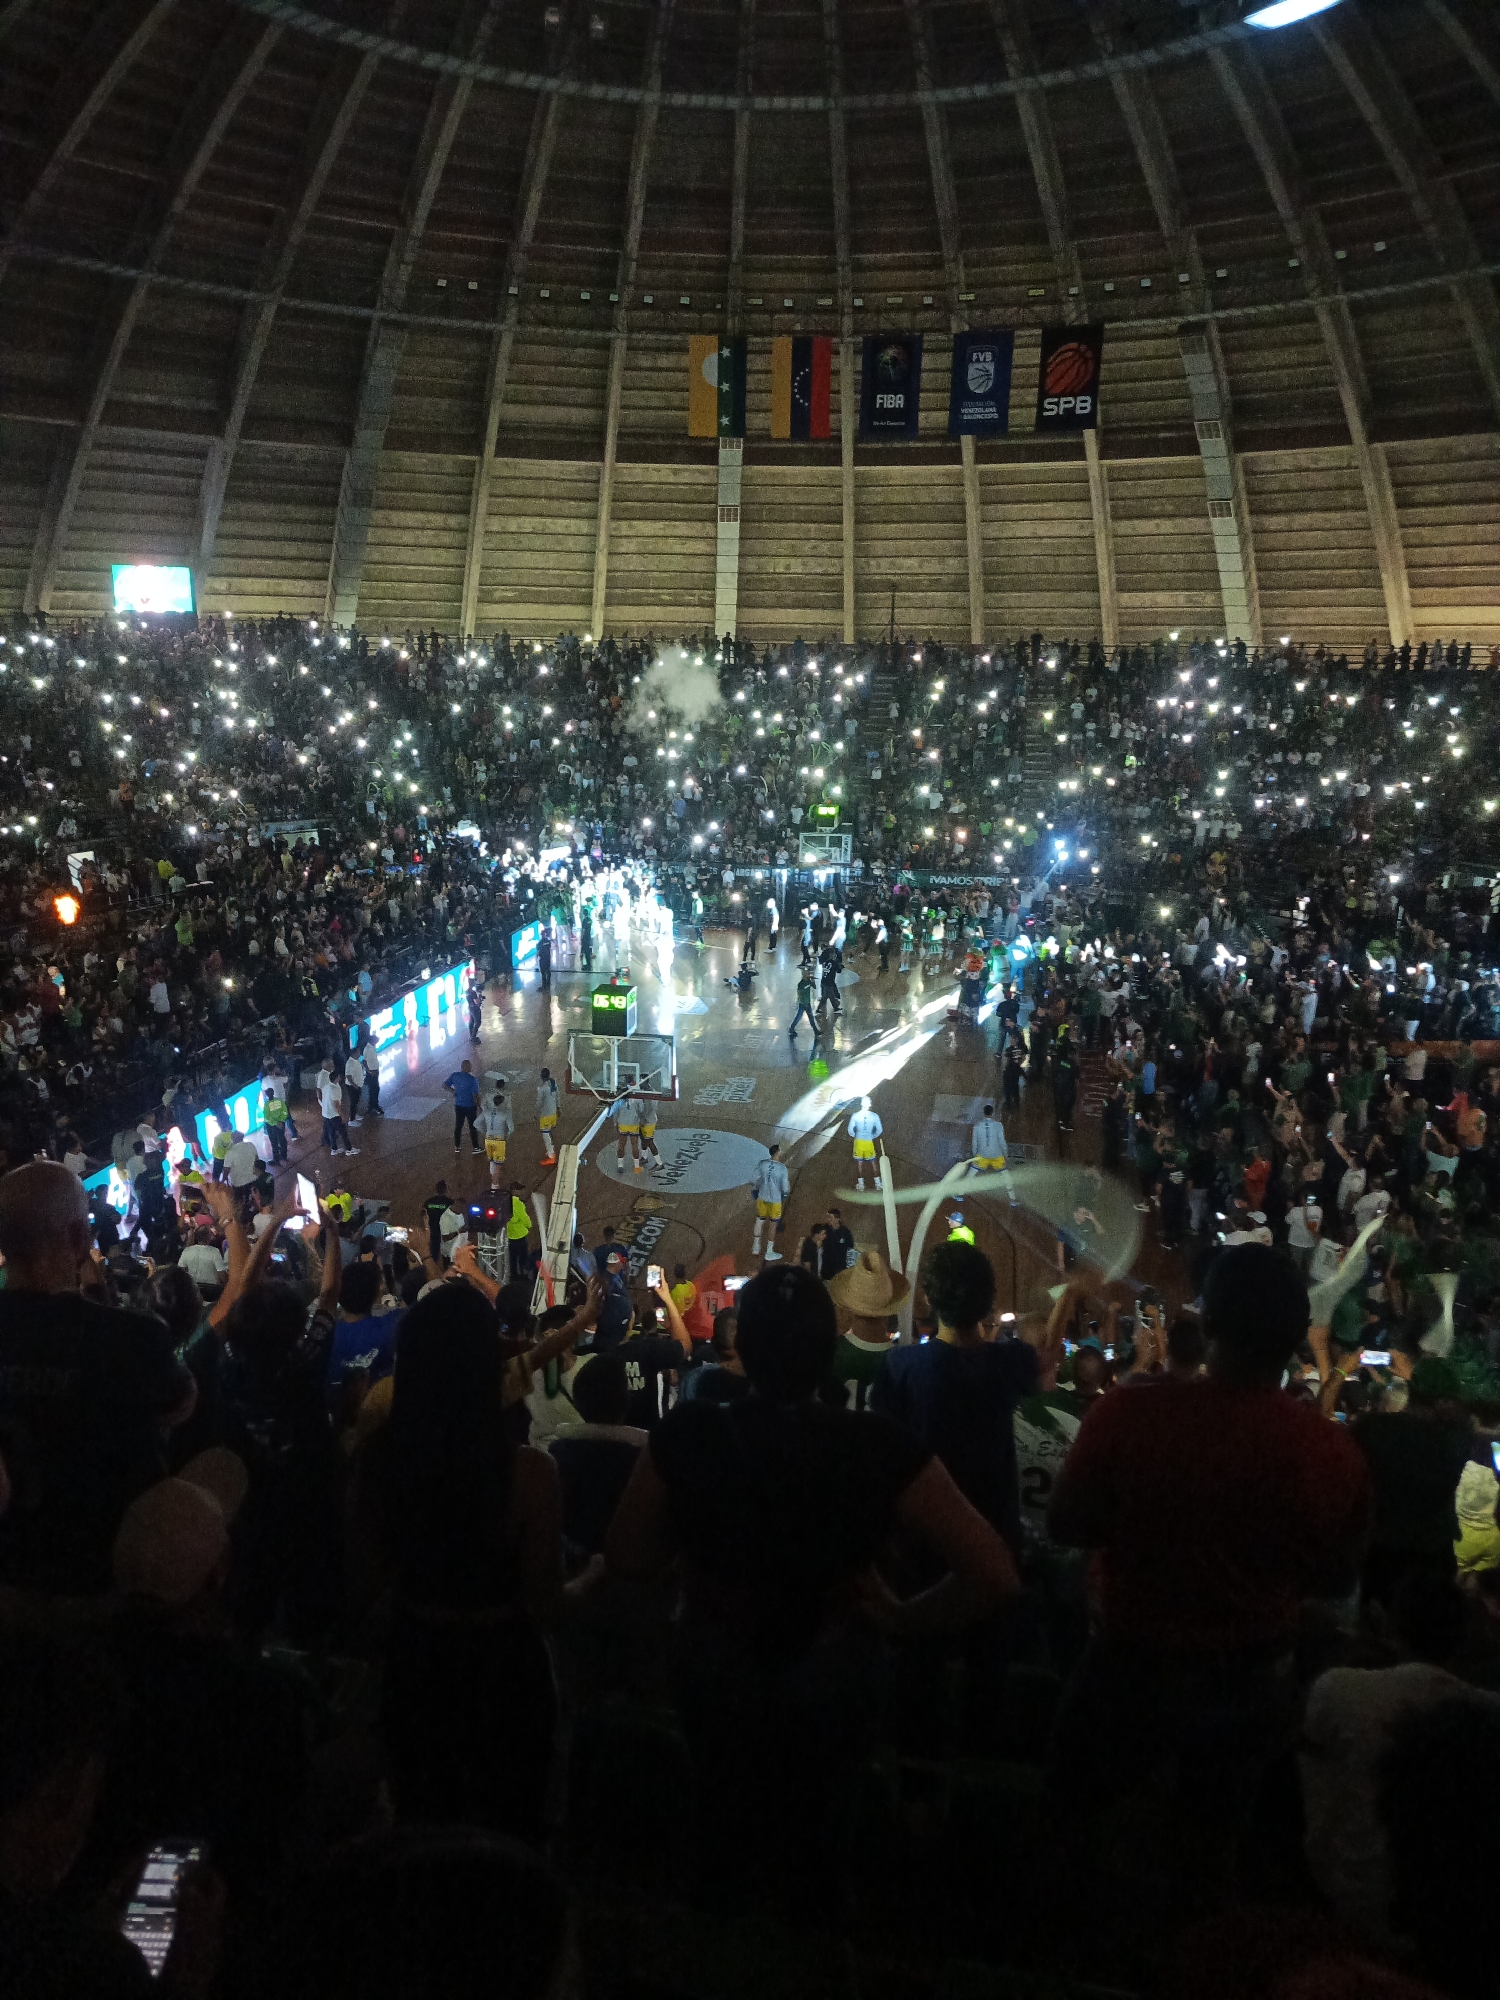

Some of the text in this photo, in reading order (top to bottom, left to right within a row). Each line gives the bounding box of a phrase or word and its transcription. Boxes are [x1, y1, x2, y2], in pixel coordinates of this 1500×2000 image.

[972, 351, 993, 362] FVB
[876, 394, 905, 409] FIBA
[1042, 395, 1092, 416] SPB
